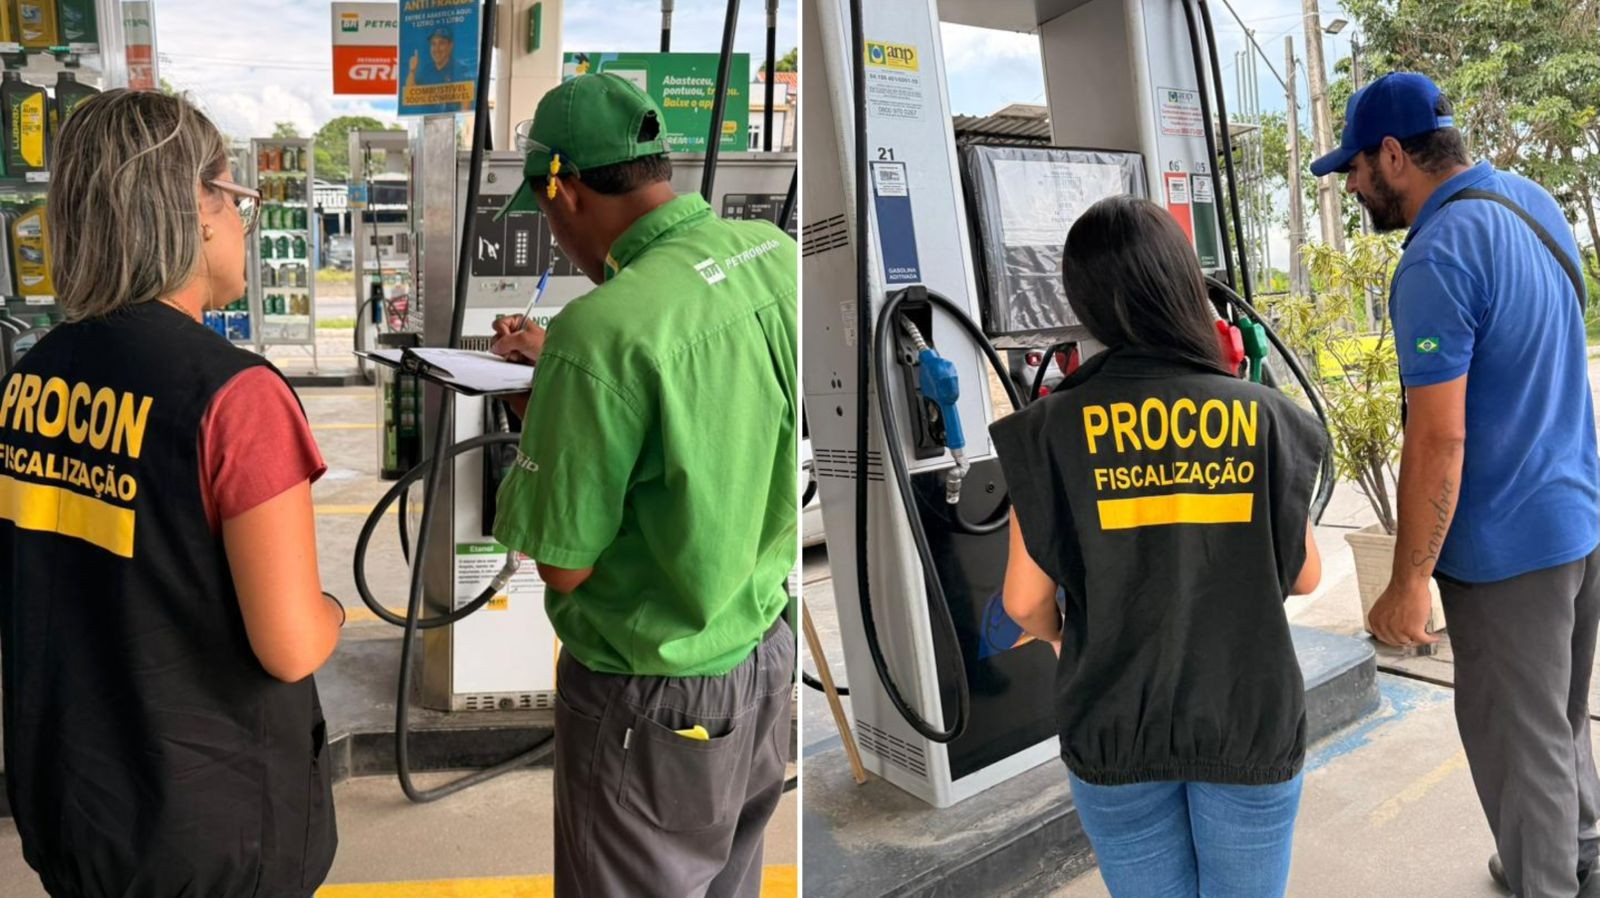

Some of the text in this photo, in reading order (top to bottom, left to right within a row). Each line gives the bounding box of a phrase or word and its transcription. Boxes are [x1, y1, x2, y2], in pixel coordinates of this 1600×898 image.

[886, 46, 914, 64] anp
[662, 75, 714, 86] Abasteceu,
[663, 86, 740, 97] pontuou, trou.
[663, 97, 689, 108] Baixe
[877, 147, 894, 161] 21
[0, 372, 154, 459] PROCON
[1083, 397, 1258, 454] PROCON
[1094, 457, 1255, 490] FISCALIZAÇÃO
